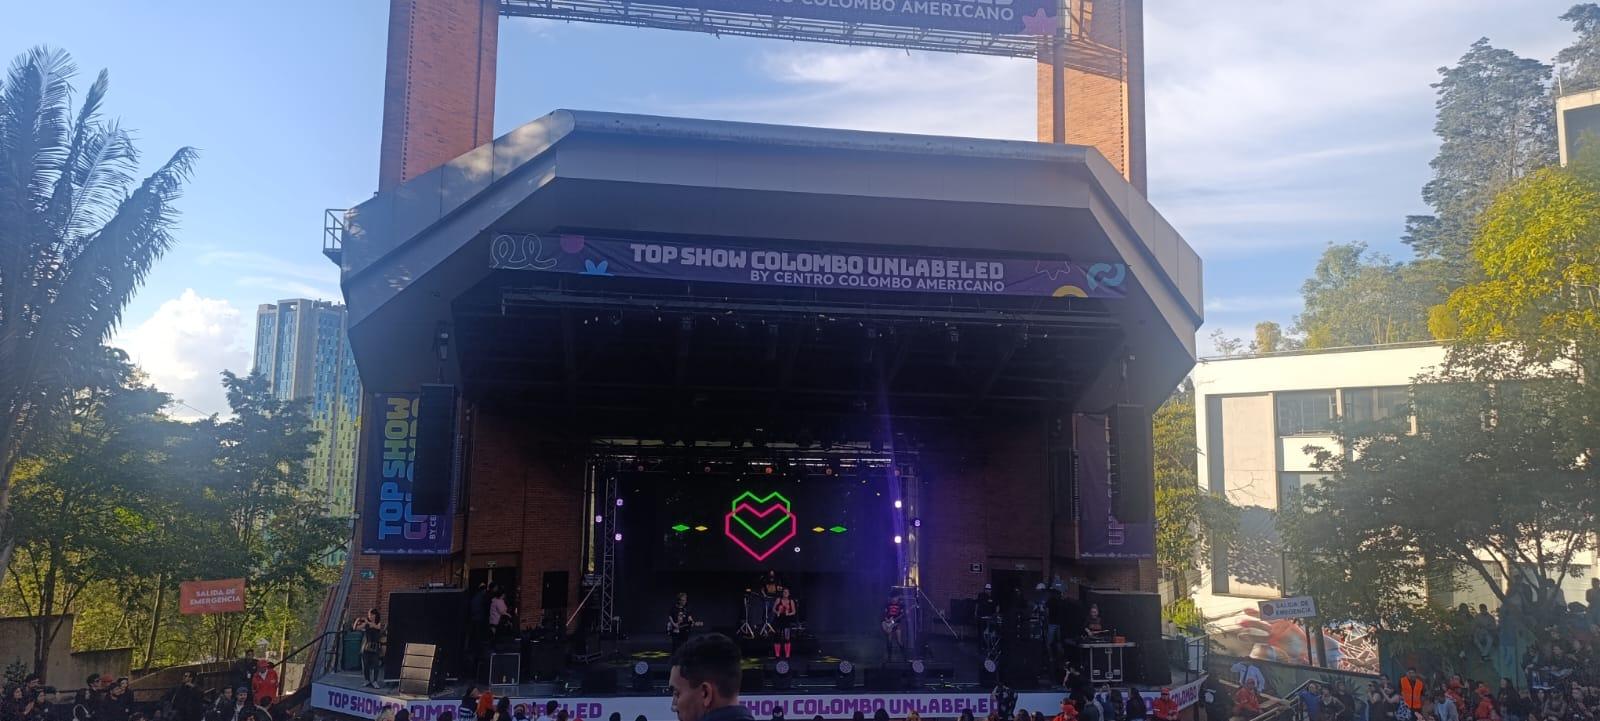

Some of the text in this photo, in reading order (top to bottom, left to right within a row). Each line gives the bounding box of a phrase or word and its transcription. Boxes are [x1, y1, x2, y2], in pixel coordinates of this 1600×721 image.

[901, 2, 1014, 20] AMERICANO
[630, 243, 1004, 280] TOP SHOW COLOMBO UNLABELED
[750, 270, 1005, 292] BY CENTRO COLOMBO AMERICANO
[378, 397, 410, 540] TOP SHOW
[190, 595, 241, 605] EMERGENCIA
[196, 589, 224, 597] SALIDA
[328, 690, 349, 708] TOP
[792, 698, 885, 715] COLOMBO
